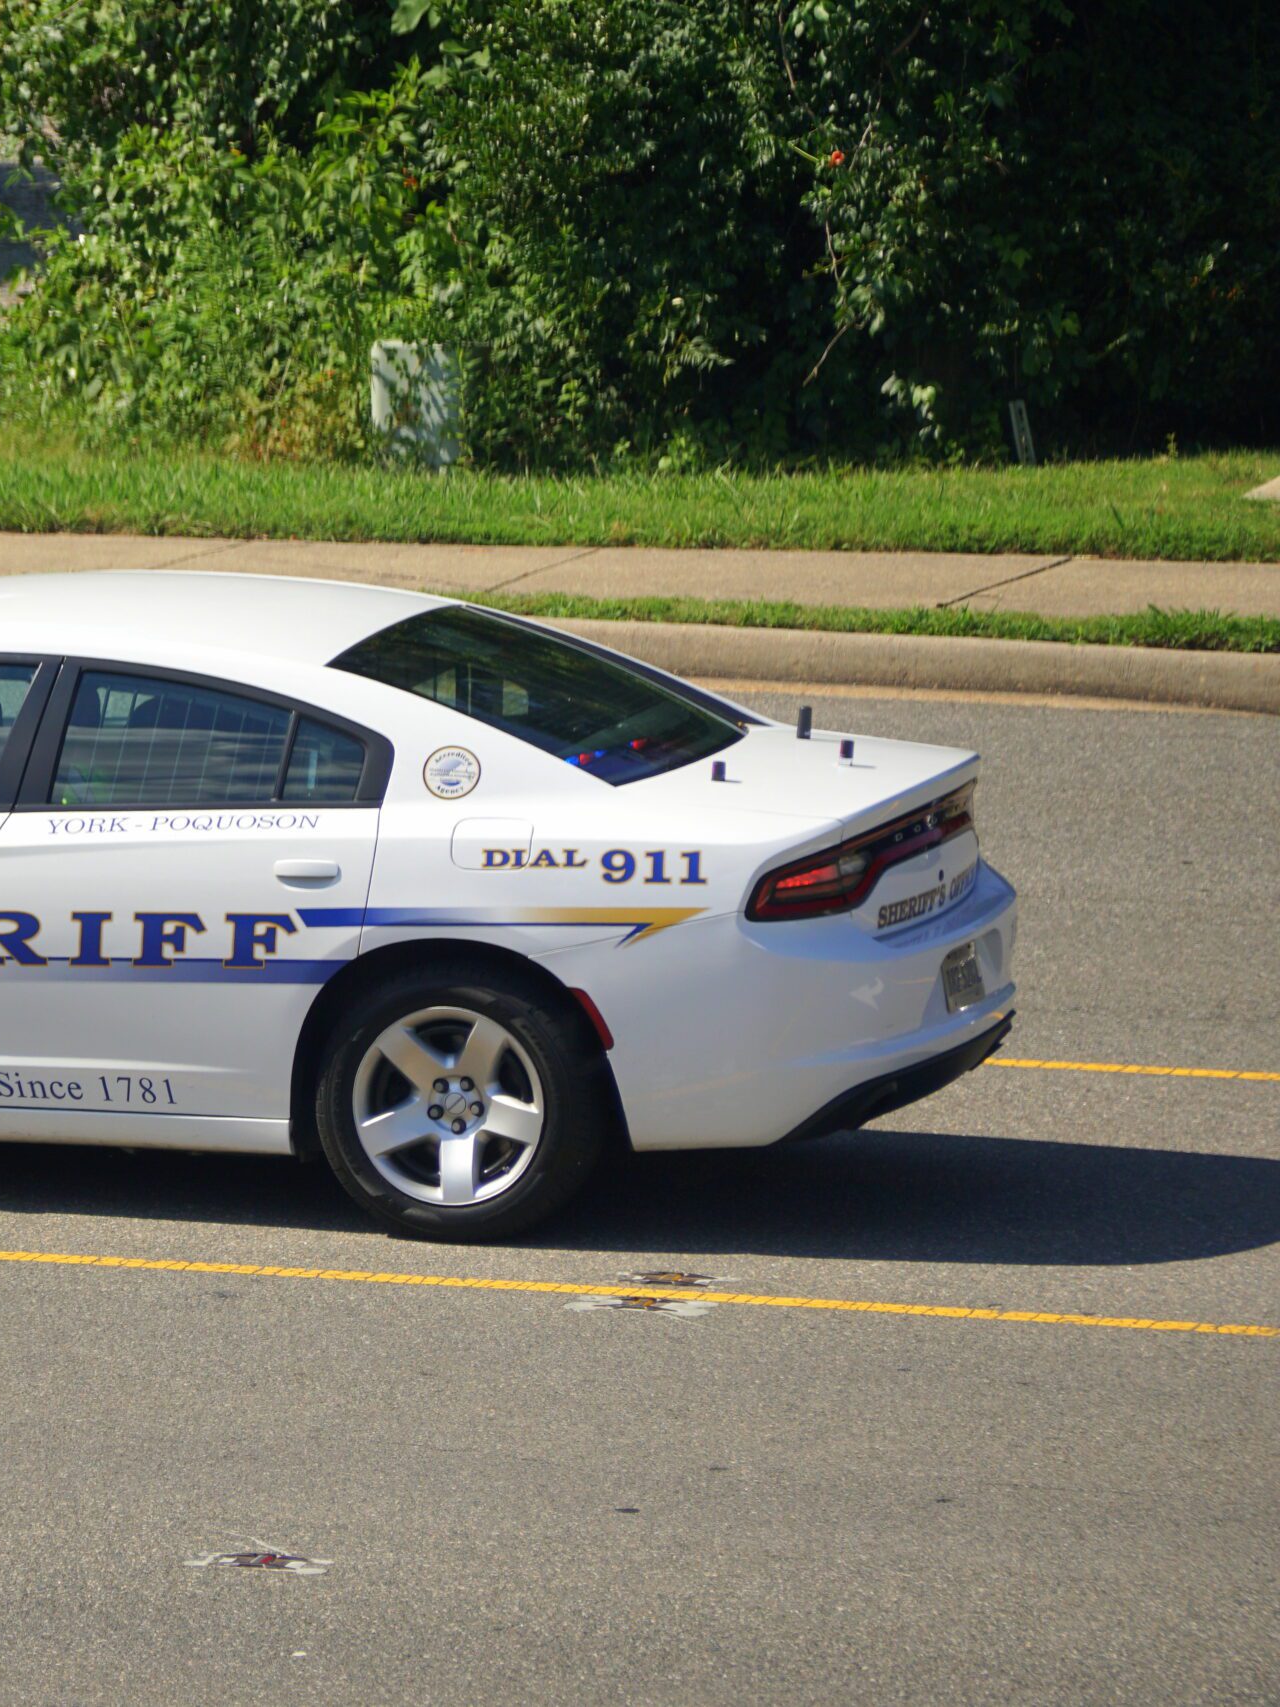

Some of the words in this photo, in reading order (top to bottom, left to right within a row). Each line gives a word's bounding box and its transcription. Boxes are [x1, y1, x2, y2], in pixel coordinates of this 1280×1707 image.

[47, 816, 131, 835] YORK
[149, 814, 320, 832] POQUOSON
[481, 848, 589, 868] DIAL
[600, 848, 708, 885] 911
[877, 884, 946, 930] SHERIFF'S
[97, 1075, 179, 1105] 1781
